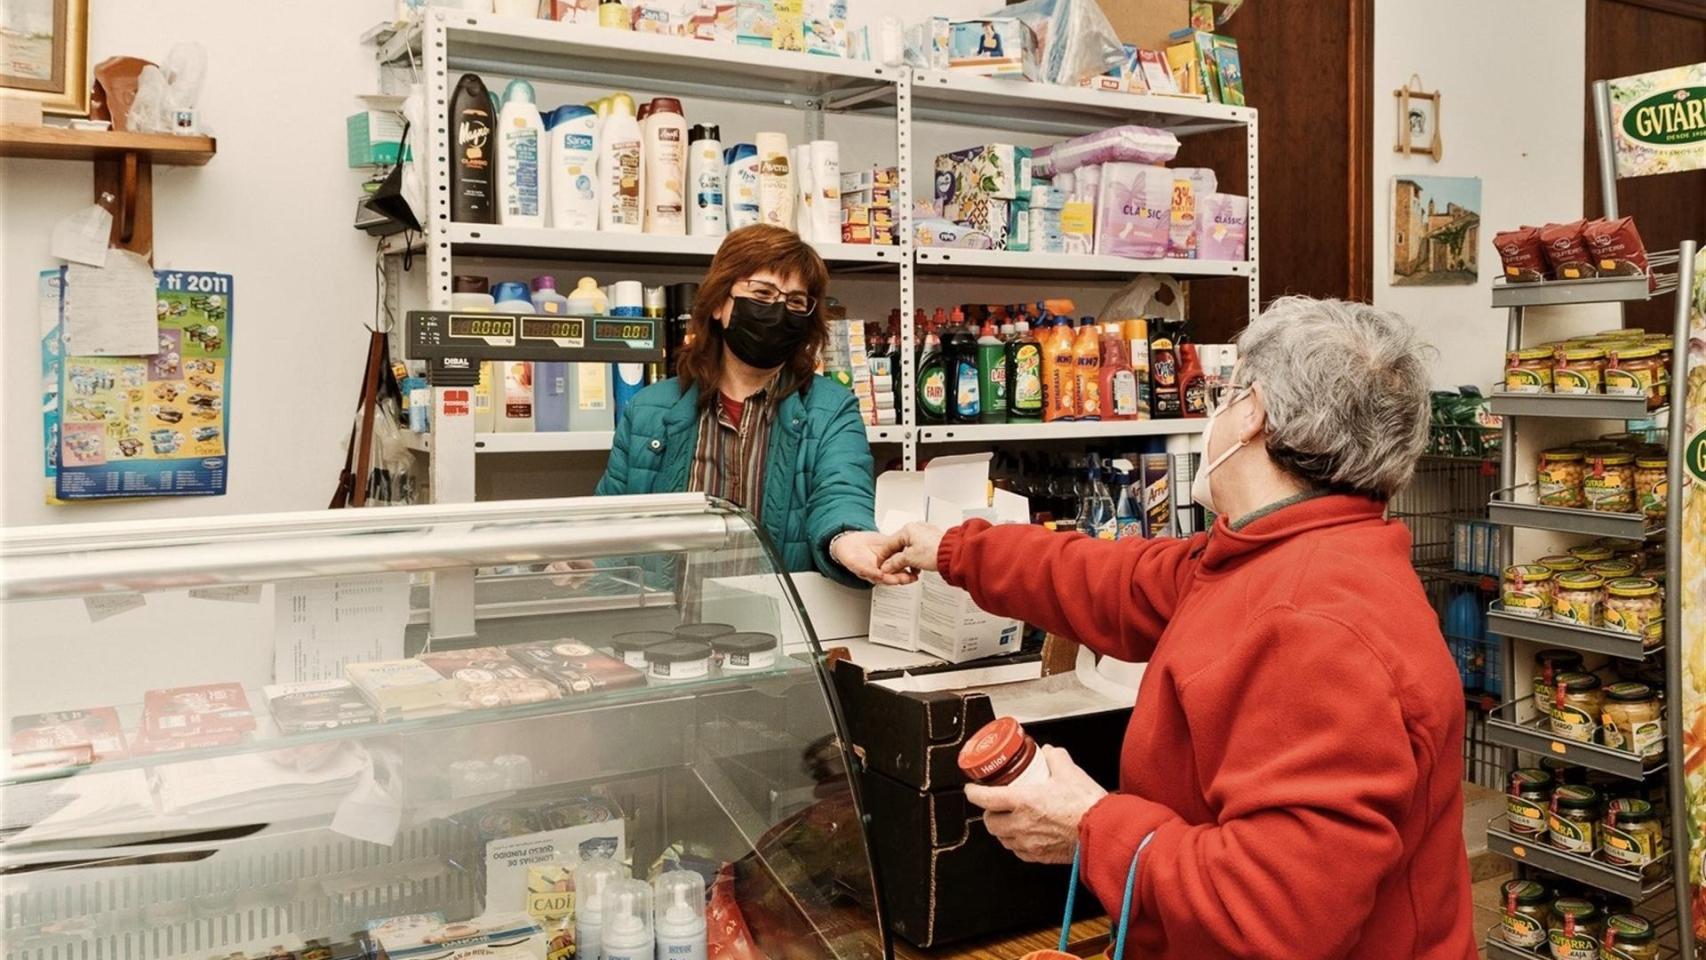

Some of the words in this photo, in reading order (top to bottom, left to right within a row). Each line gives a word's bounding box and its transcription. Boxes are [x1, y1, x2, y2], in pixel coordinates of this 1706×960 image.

[1636, 98, 1706, 137] GVTAR
[566, 135, 592, 147] Sanex
[761, 162, 789, 173] Avena
[1123, 205, 1161, 220] CLASIC
[1214, 216, 1242, 224] CLASSIC
[187, 275, 227, 293] 2011
[472, 321, 511, 335] 0.000
[1056, 354, 1072, 364] KH7
[1078, 356, 1098, 367] KH7
[927, 386, 943, 397] FAIRY
[980, 754, 1007, 774] Helios
[493, 850, 527, 859] FUNDIDO
[528, 845, 554, 854] QUESO
